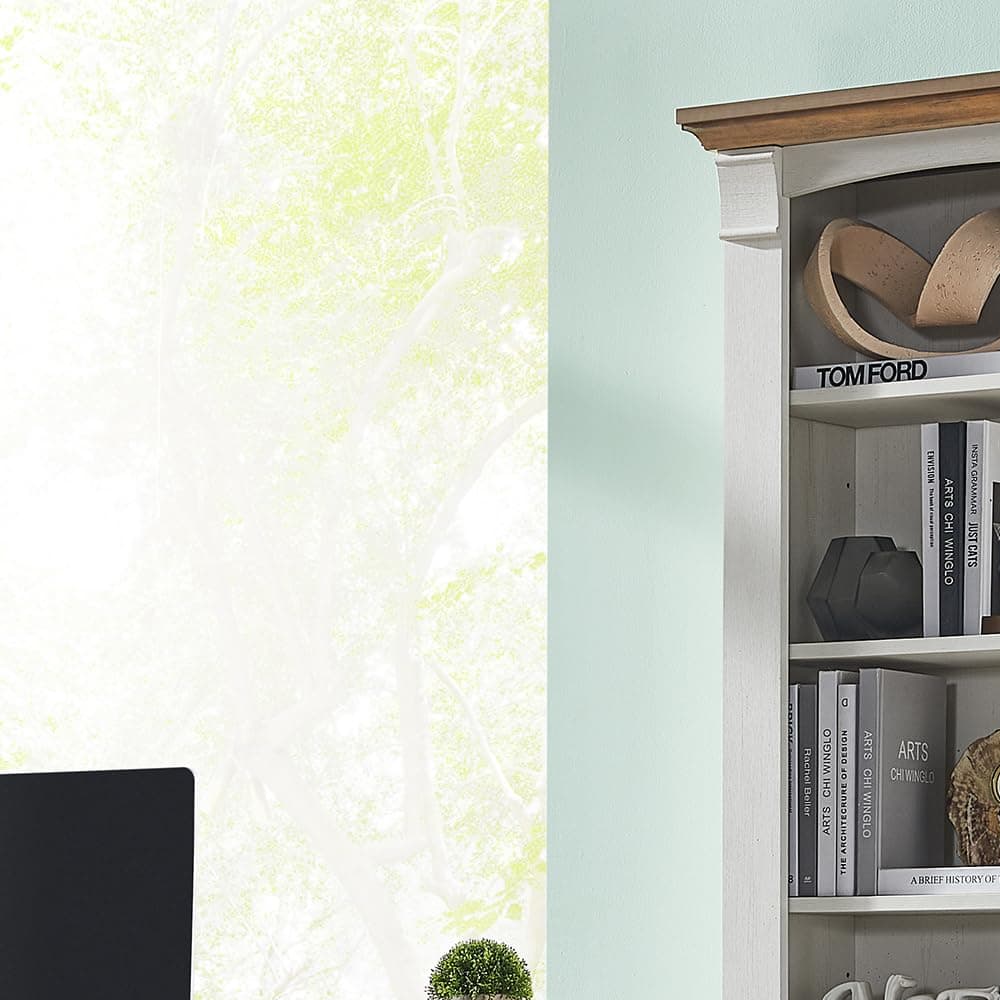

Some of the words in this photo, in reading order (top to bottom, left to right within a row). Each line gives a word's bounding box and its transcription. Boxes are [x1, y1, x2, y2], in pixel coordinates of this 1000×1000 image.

[816, 364, 866, 389] TOM
[867, 359, 928, 385] FORD
[926, 450, 935, 484] ENVISION
[971, 444, 979, 469] INSTA
[944, 478, 954, 508] ARTS
[970, 471, 978, 515] GRAMMAR
[944, 512, 954, 533] CHI
[968, 522, 979, 541] JUST
[944, 538, 954, 586] WINGLO
[968, 544, 978, 568] CATS
[823, 728, 832, 775] WINGLO
[863, 730, 873, 760] ARTS
[898, 740, 929, 761] ARTS
[840, 768, 848, 780] OF
[863, 768, 873, 789] CHI
[890, 767, 905, 781] CHI
[905, 769, 935, 784] WINGLO
[822, 778, 831, 798] CHI
[822, 806, 831, 836] ARTS
[862, 791, 872, 838] WINGLO
[910, 876, 918, 885] A
[918, 875, 945, 884] BRIEF
[945, 875, 984, 884] HISTORY
[985, 875, 997, 884] OF
